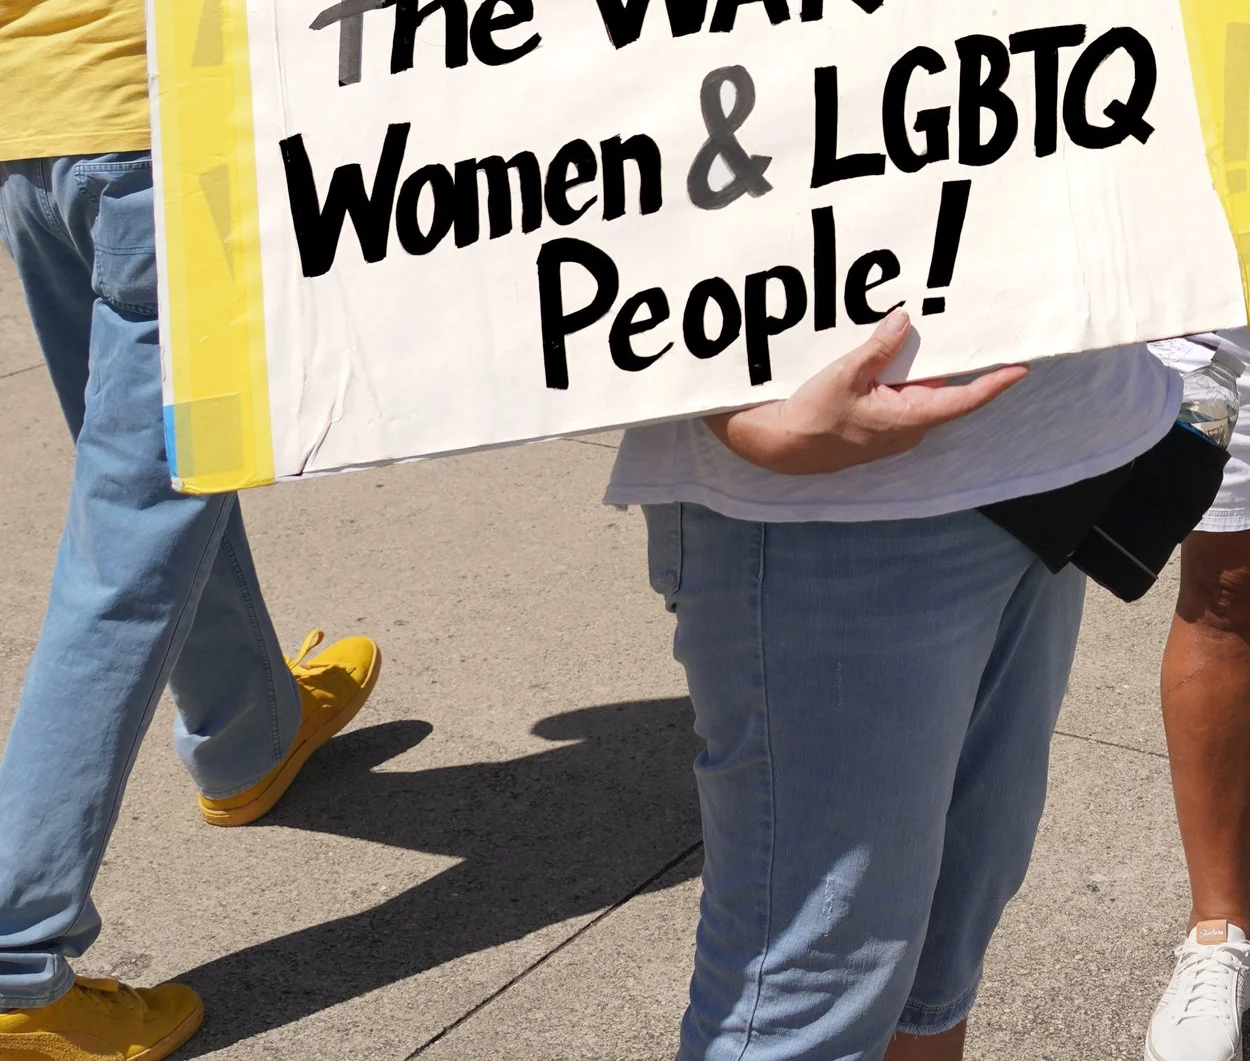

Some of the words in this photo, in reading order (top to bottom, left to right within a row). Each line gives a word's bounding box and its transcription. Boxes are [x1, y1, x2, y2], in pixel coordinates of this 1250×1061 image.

[280, 121, 663, 278] Women
[687, 63, 773, 210] &
[809, 24, 1158, 188] LGBTQ
[537, 179, 972, 390] People!
